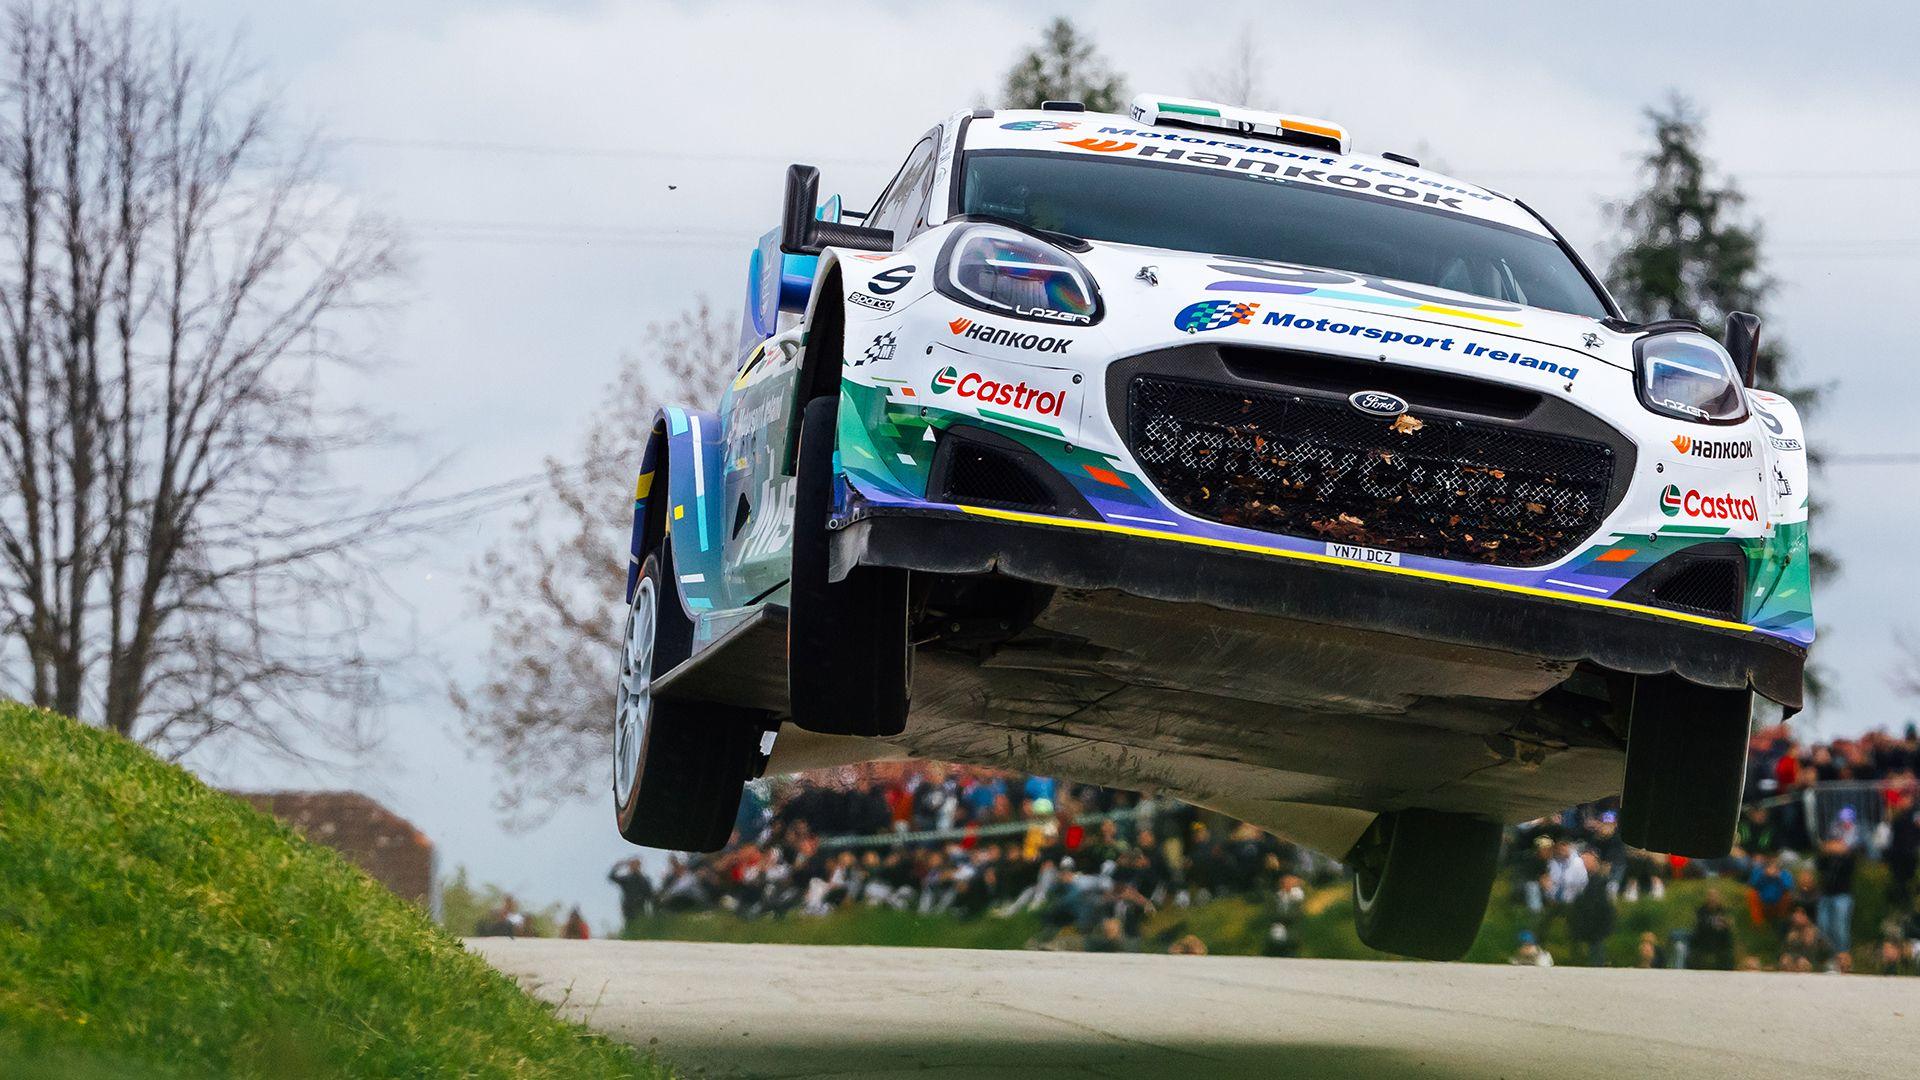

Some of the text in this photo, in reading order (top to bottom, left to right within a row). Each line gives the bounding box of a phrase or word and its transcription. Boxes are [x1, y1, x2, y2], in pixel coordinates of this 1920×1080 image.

[1098, 127, 1495, 202] Motorsport Ireland
[850, 291, 894, 310] sparco
[1015, 304, 1091, 325] LAZER
[1262, 311, 1580, 381] Motorsport Ireland
[957, 372, 1067, 417] Castrol
[1362, 394, 1397, 412] Ford
[1650, 395, 1710, 421] LAZER
[1684, 489, 1759, 522] Castrol
[1333, 544, 1392, 564] YN71 DCZ
